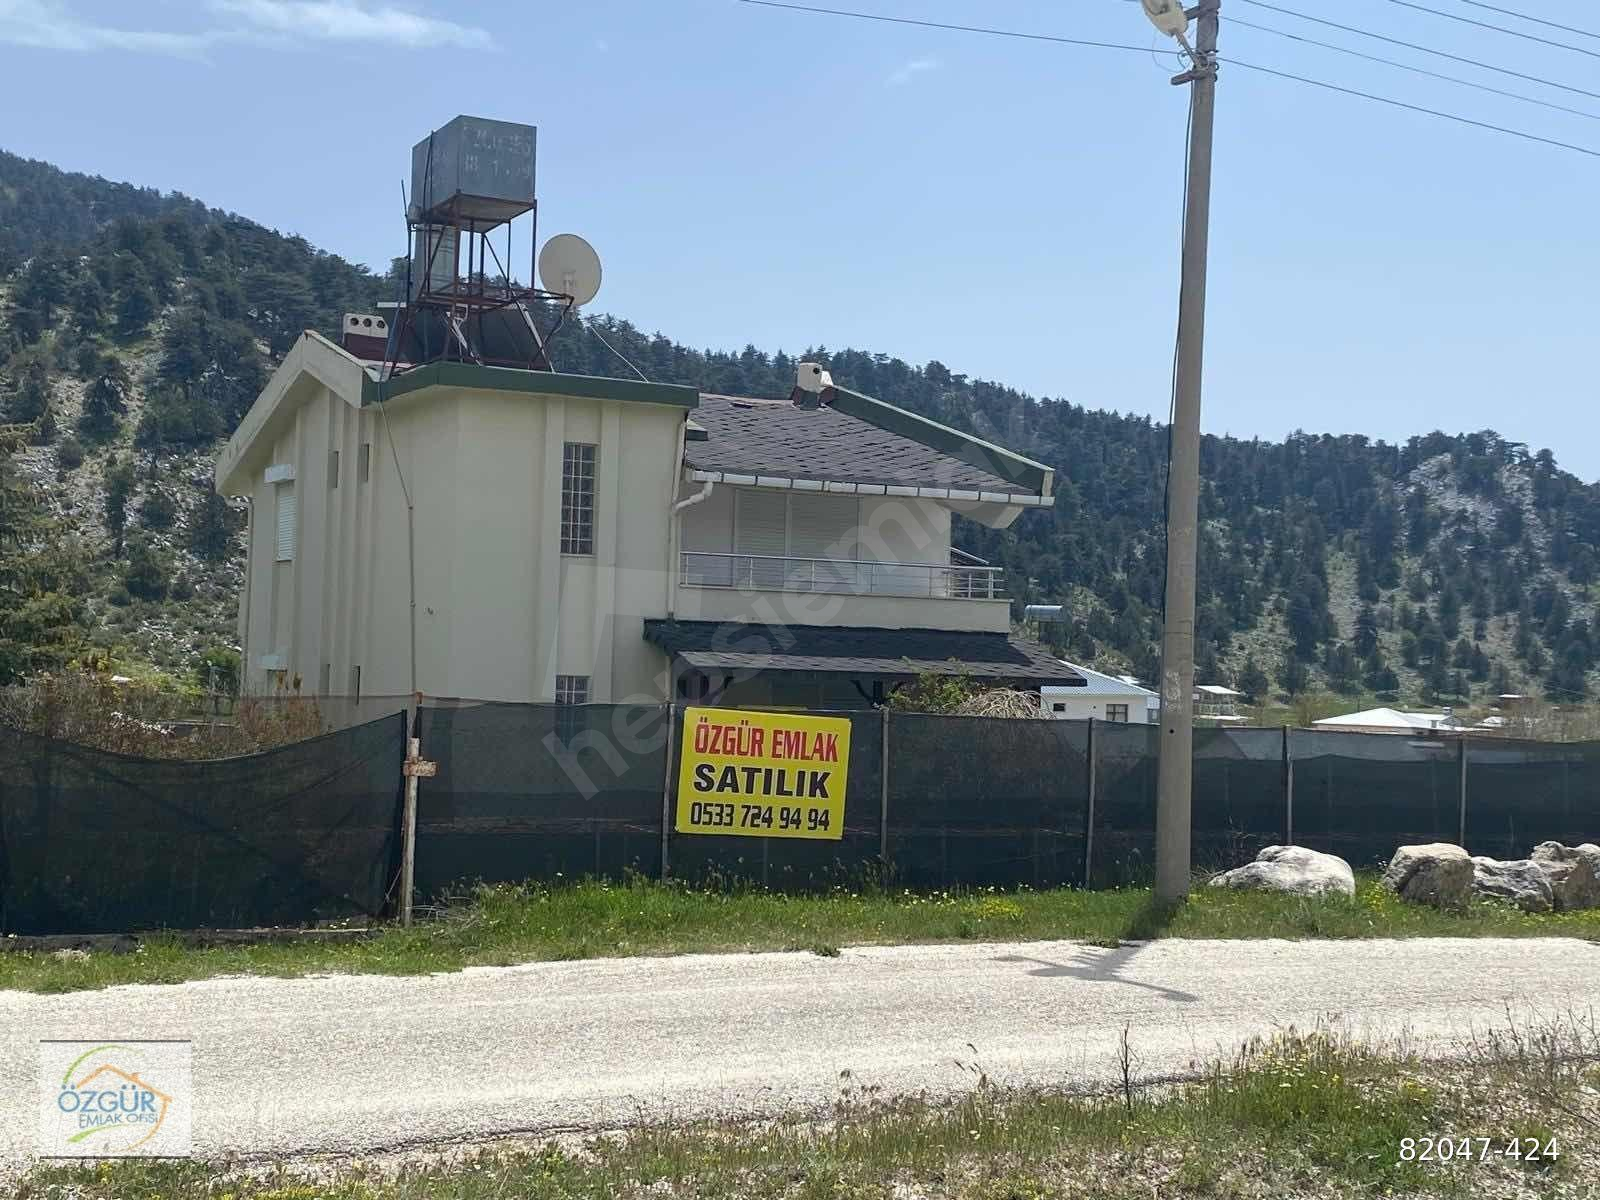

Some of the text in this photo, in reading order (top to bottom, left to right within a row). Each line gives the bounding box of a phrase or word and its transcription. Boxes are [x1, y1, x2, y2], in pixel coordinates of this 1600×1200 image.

[695, 716, 838, 762] ÖZGÜR EMLAK
[694, 763, 831, 798] SATILIK
[690, 802, 830, 831] 0533 724 94 94
